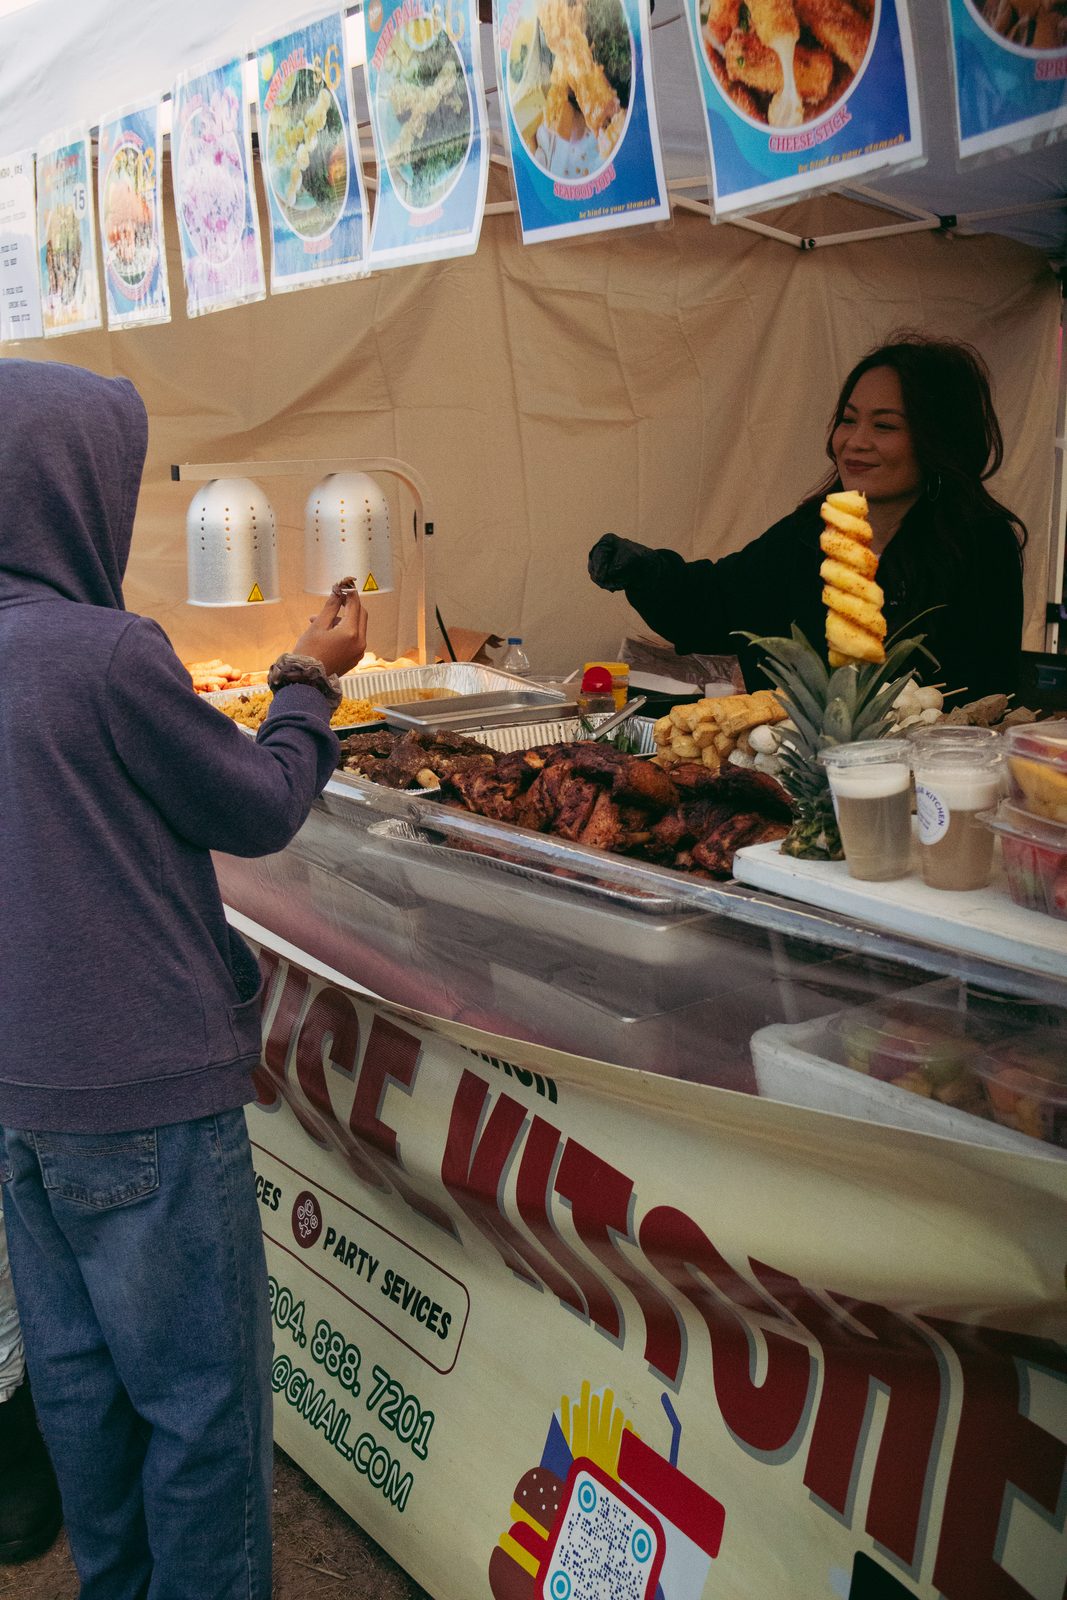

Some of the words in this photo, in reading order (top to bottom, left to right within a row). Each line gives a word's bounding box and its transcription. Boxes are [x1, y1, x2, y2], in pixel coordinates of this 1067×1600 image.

[769, 134, 814, 152] CHEESE
[815, 105, 851, 143] STICK
[831, 154, 841, 163] to
[841, 148, 862, 160] your
[864, 134, 905, 153] stomach
[554, 183, 593, 199] SEAFOOD
[594, 163, 616, 193] TOFU
[73, 190, 86, 211] 15
[602, 207, 610, 215] to
[610, 204, 625, 215] your
[626, 197, 656, 210] stomach
[925, 790, 945, 827] KITCHEN
[322, 1226, 380, 1284] PARTY
[380, 1269, 452, 1341] SEVICES
[311, 1319, 362, 1398] 888.
[366, 1364, 435, 1460] 7201
